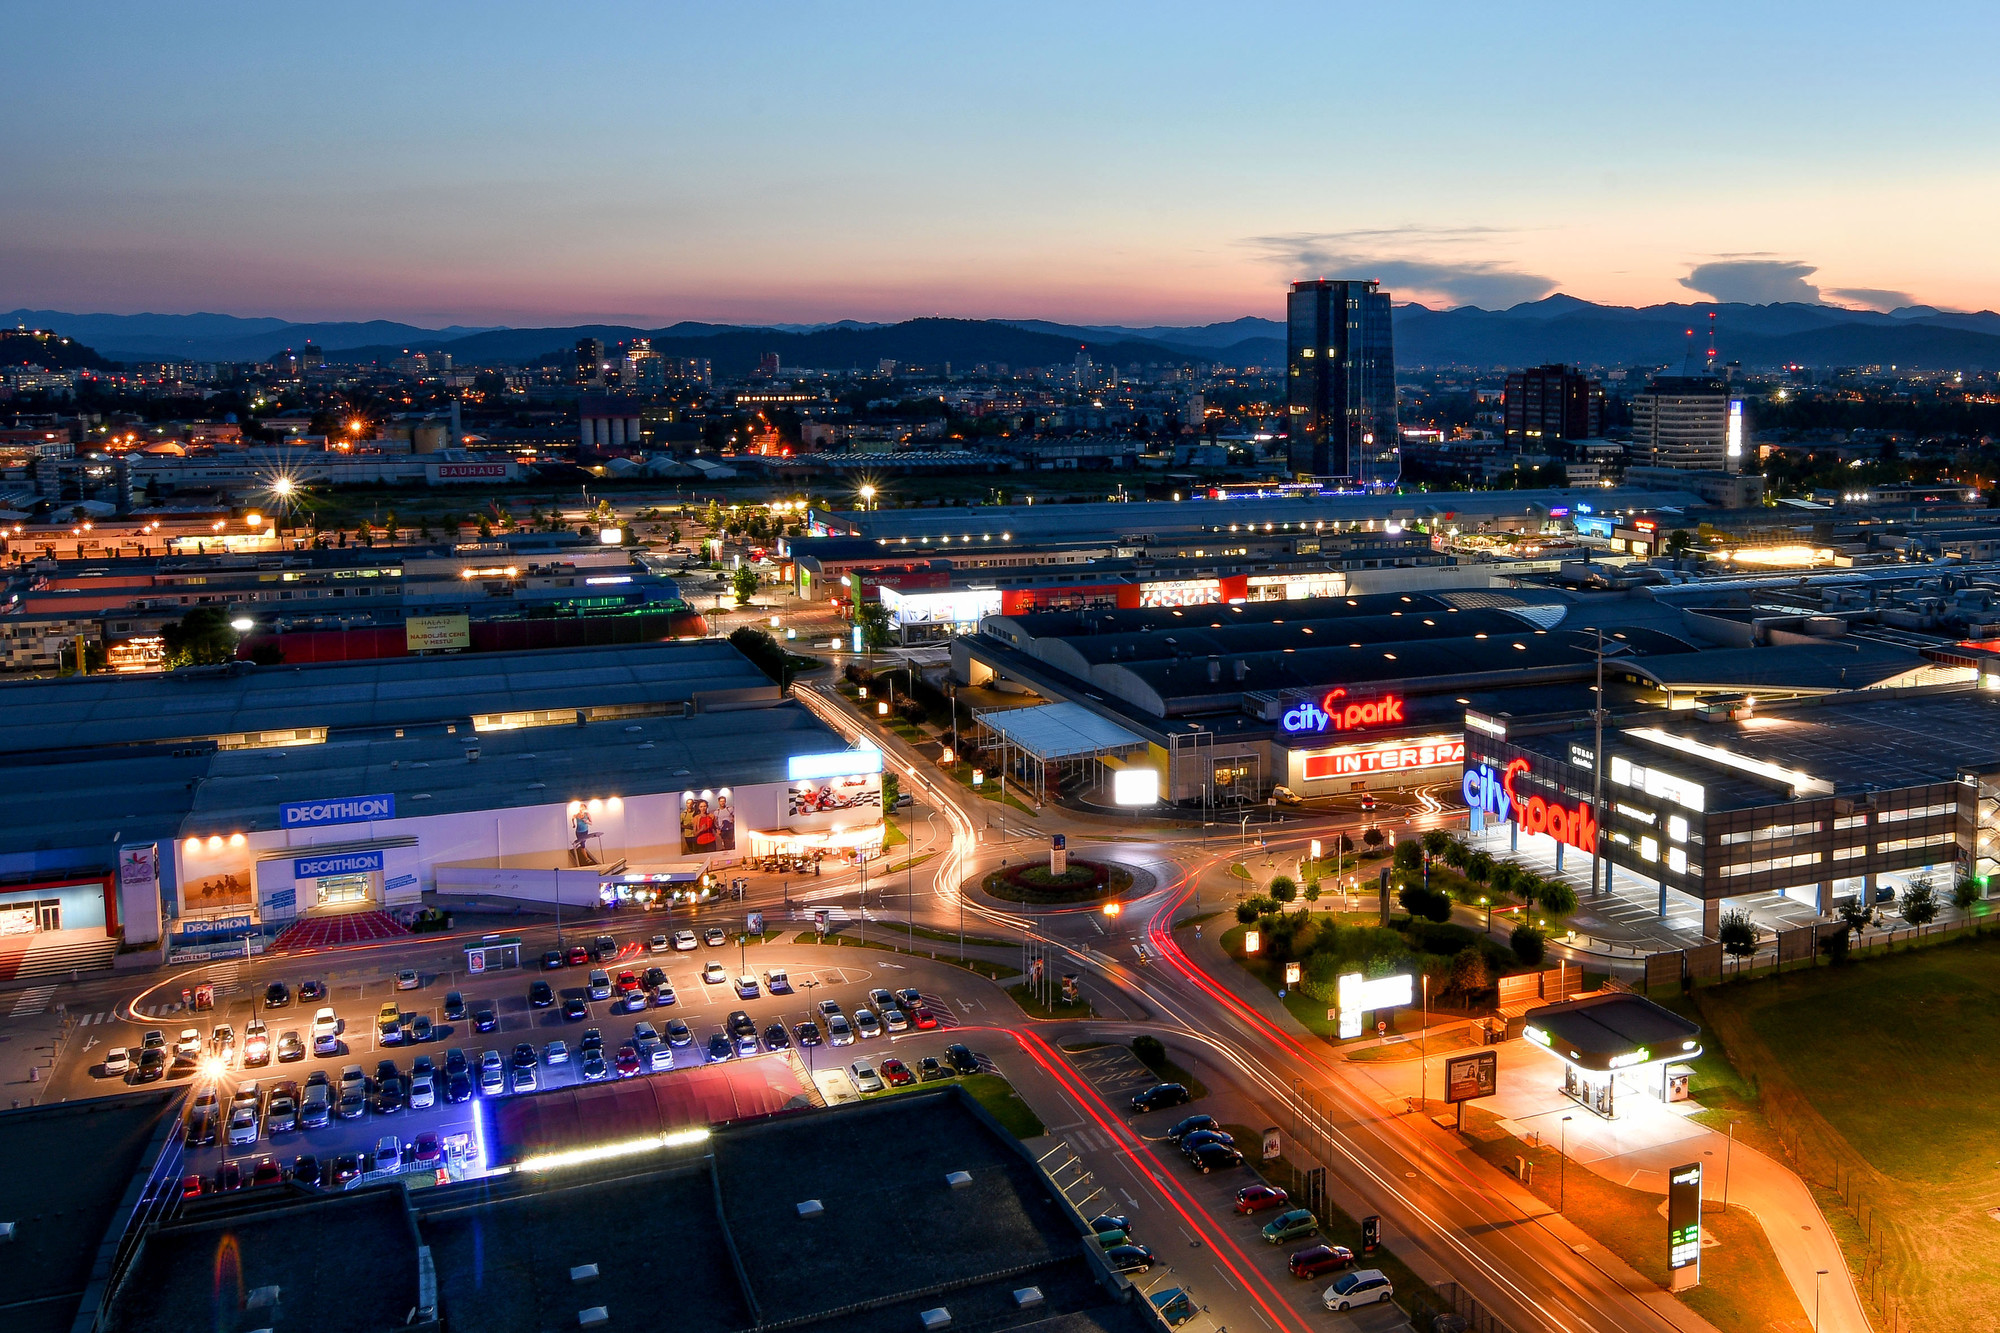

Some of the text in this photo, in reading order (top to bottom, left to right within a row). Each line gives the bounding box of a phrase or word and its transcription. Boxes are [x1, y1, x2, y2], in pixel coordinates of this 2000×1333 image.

[440, 466, 504, 476] BAUHAUS
[1283, 695, 1404, 732] city park
[287, 800, 388, 822] DECATHLON
[1462, 764, 1596, 854] city park
[300, 856, 378, 874] DECATHLON
[186, 918, 247, 933] DECATHLON
